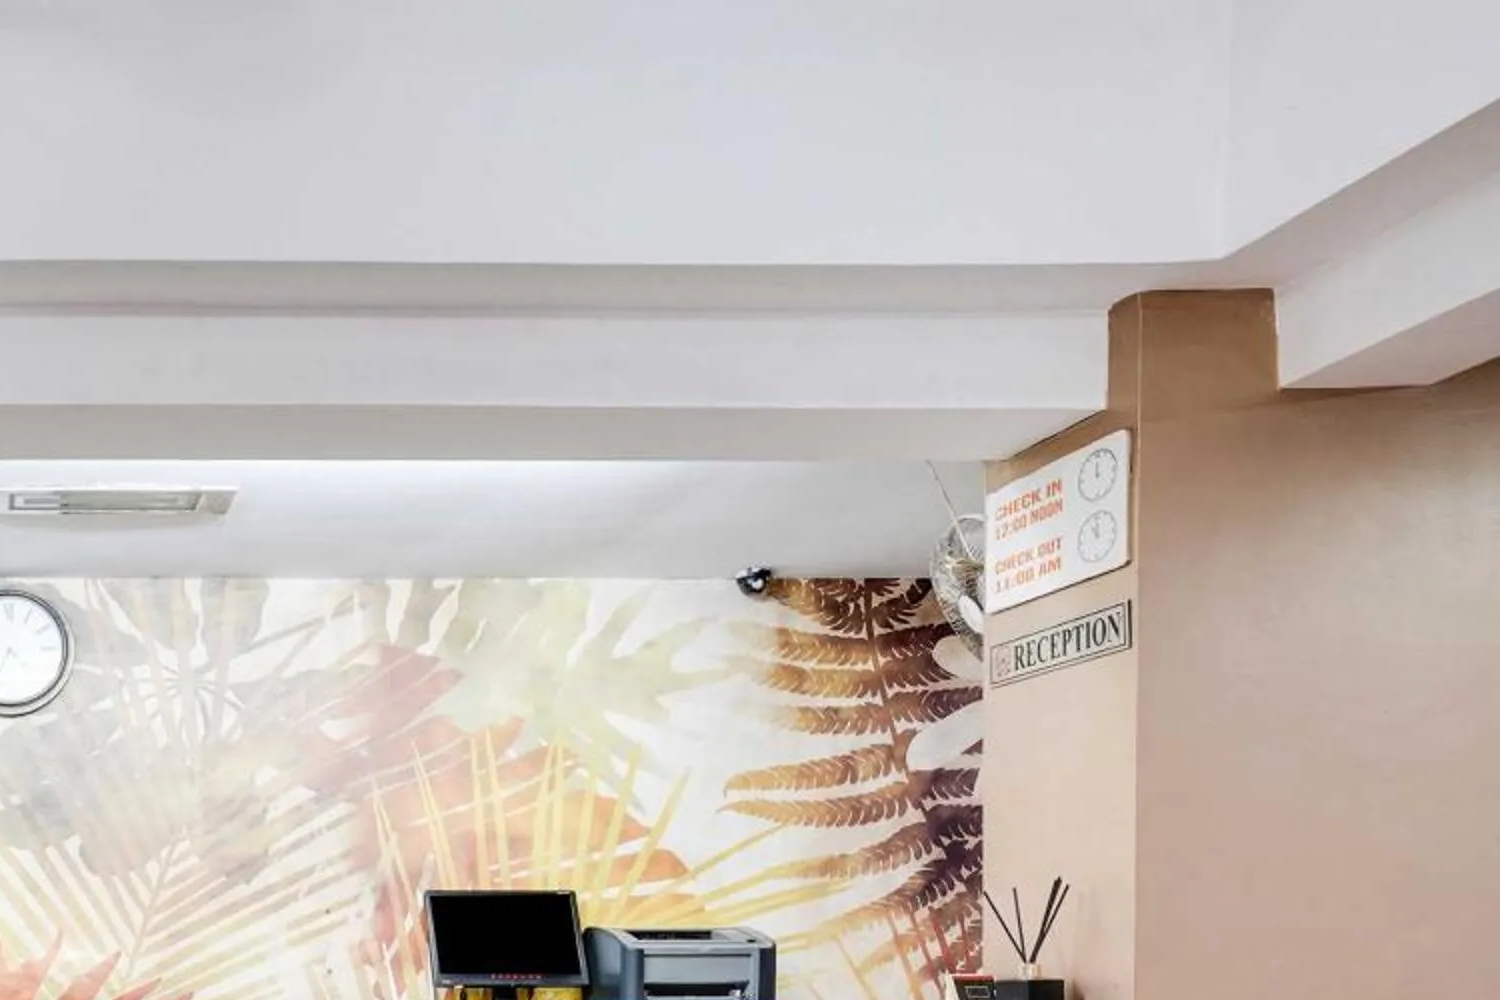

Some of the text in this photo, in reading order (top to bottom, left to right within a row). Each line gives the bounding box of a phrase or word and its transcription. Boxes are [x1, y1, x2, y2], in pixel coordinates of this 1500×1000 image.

[995, 479, 1062, 521] CHECK IN
[995, 498, 1063, 541] 12:00 NOON
[995, 536, 1062, 575] CHECK OUT
[996, 557, 1061, 593] 11:00 AM
[1014, 611, 1122, 672] RECEPTION
